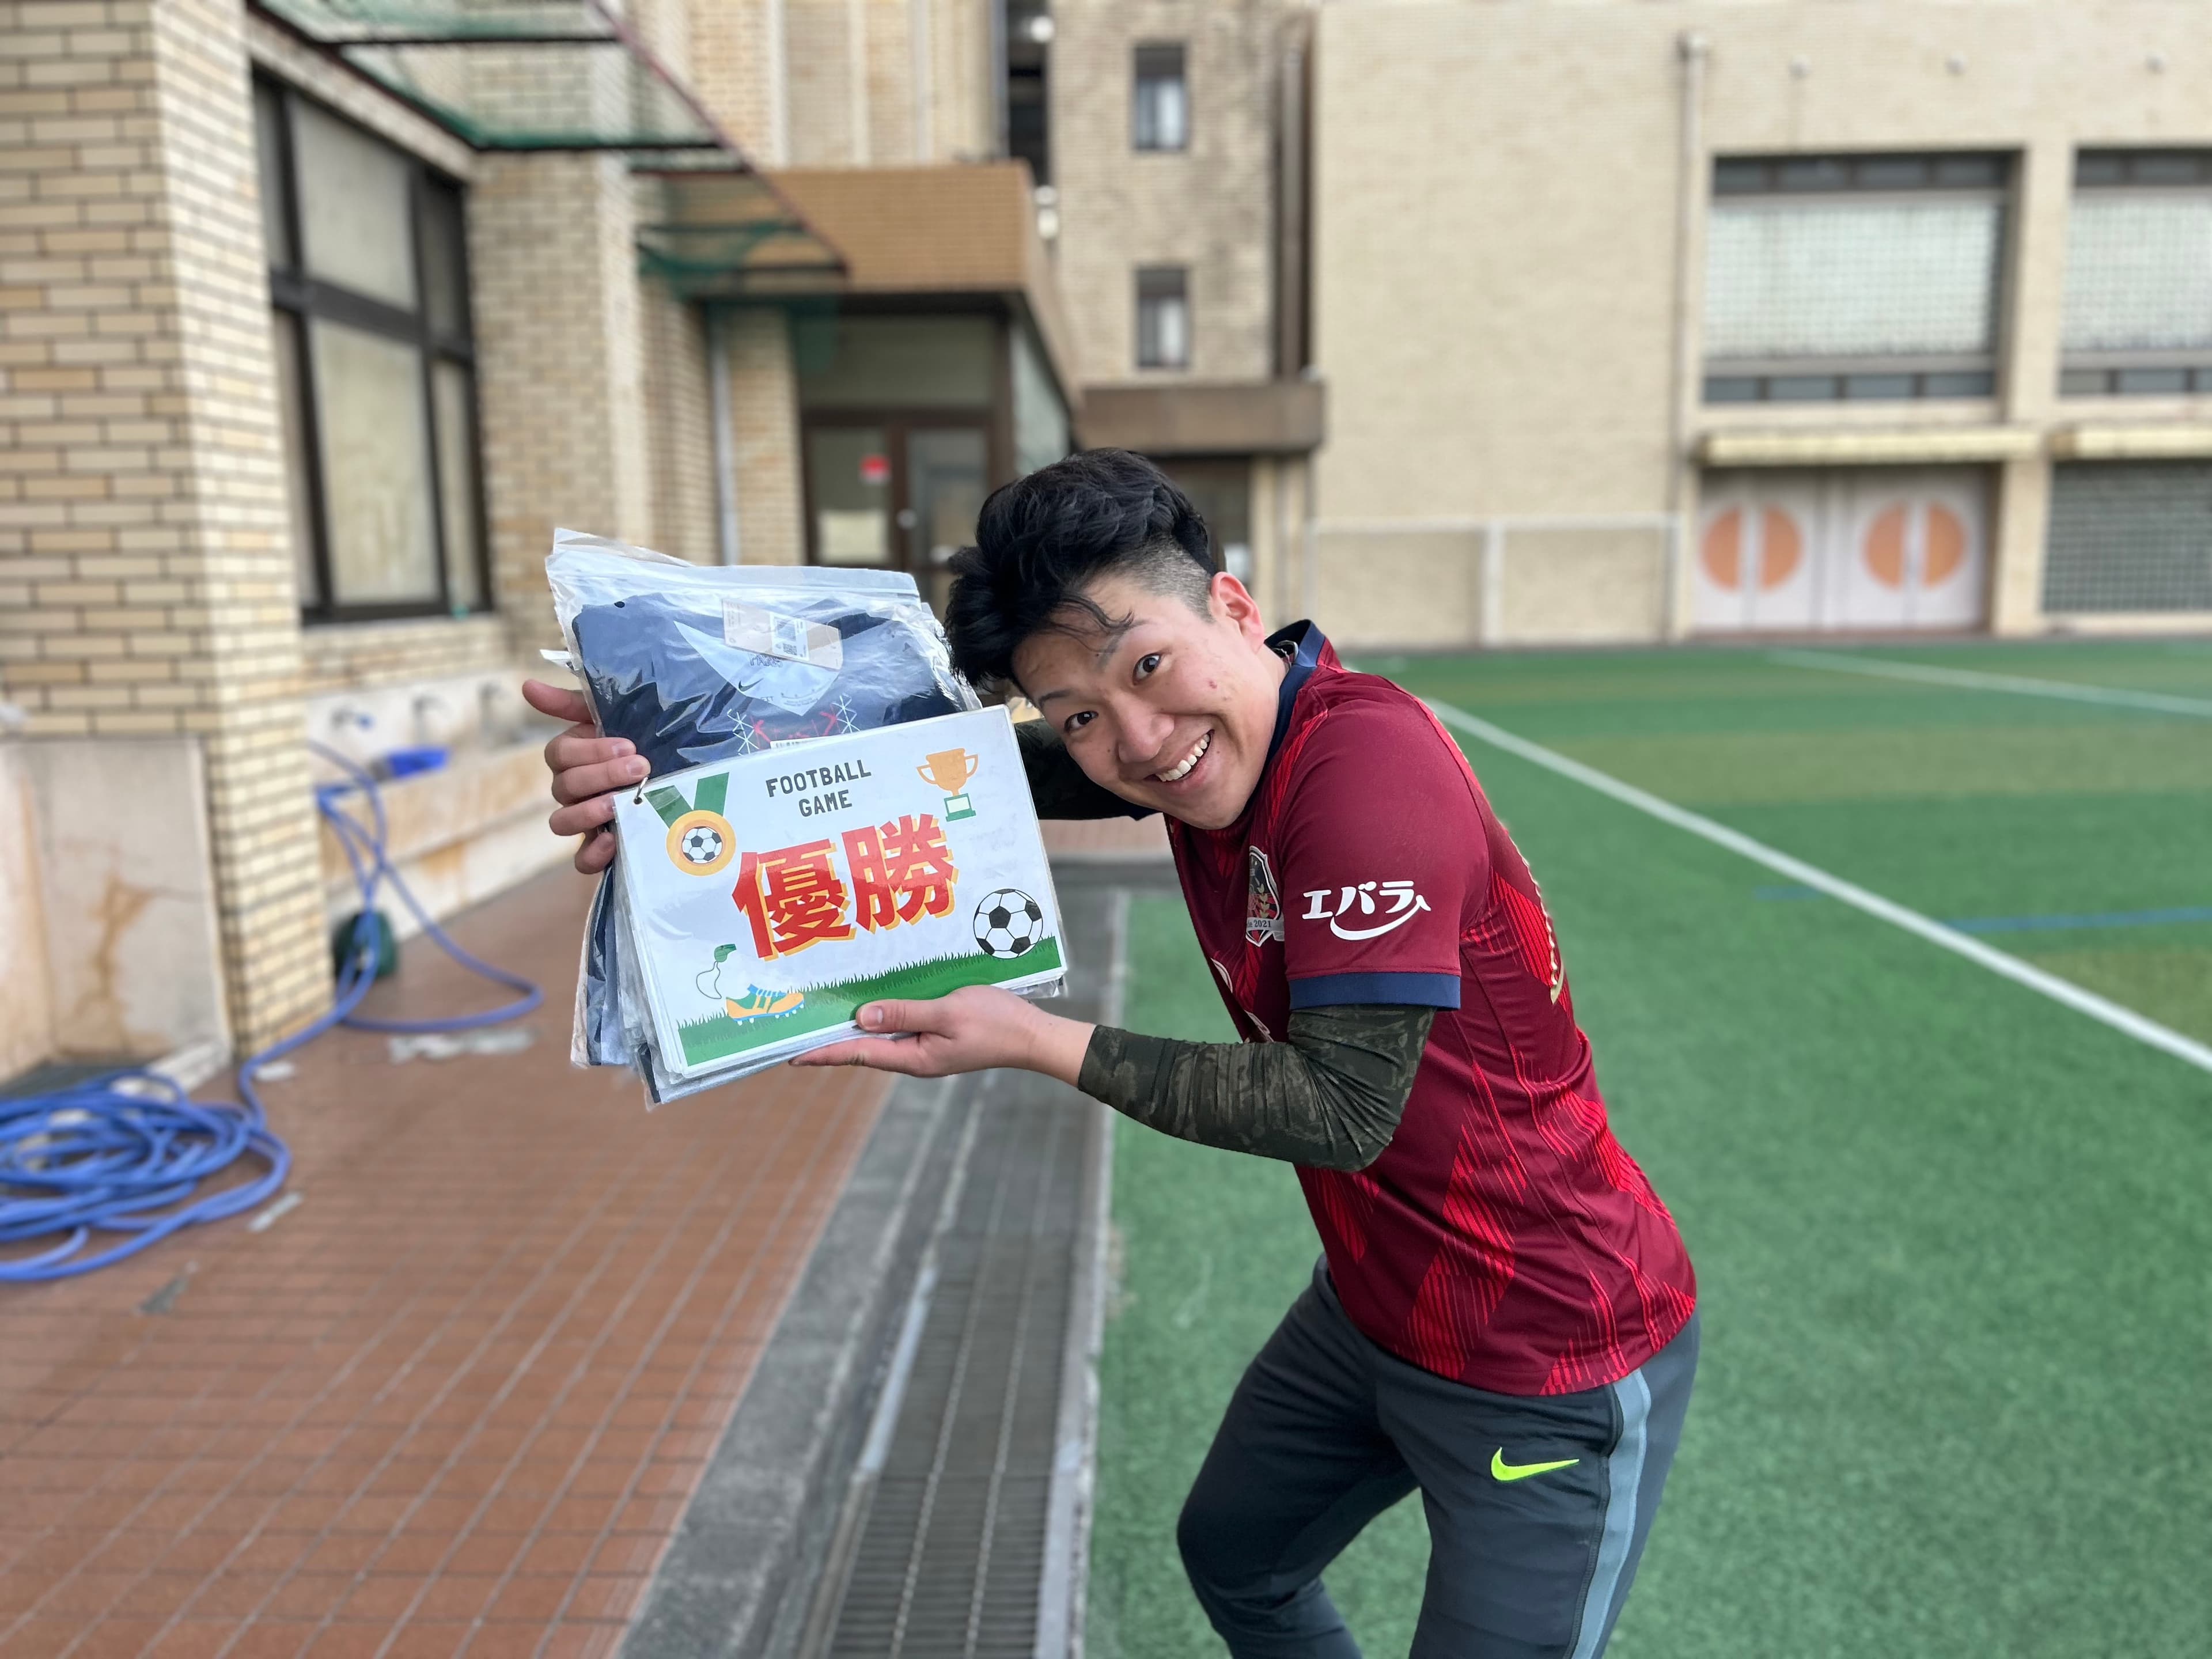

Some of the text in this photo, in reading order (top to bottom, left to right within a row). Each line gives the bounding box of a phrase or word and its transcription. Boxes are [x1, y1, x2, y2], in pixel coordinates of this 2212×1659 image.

[765, 759, 872, 798] FOOTBALL
[798, 789, 853, 817] GAME
[732, 813, 959, 961] 優勝
[1302, 880, 1415, 920] エバラ
[1253, 920, 1272, 928] 2021
